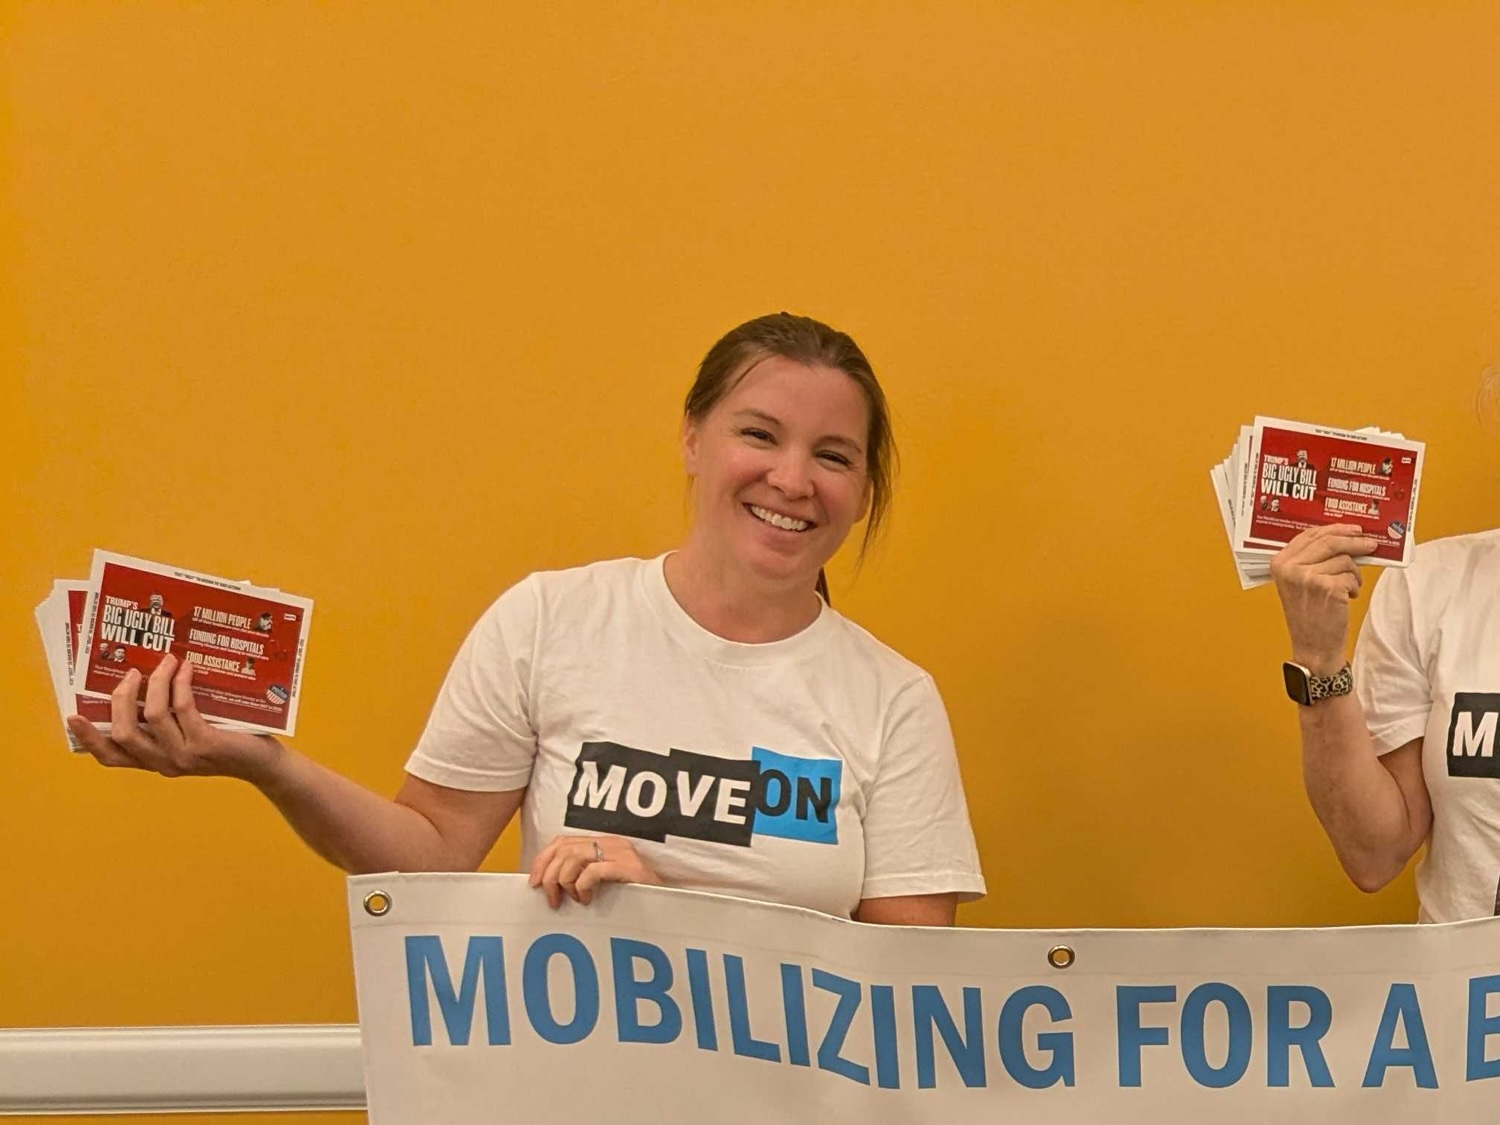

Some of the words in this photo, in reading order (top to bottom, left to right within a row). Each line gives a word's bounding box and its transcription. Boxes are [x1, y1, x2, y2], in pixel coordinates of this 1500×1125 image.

[1262, 462, 1277, 479] BIG
[1278, 465, 1299, 483] UGLY
[1300, 468, 1317, 486] BILL
[1261, 478, 1289, 497] WILL
[1292, 483, 1317, 501] CUT
[105, 595, 139, 610] TRUMP'S
[102, 604, 122, 625] BIG
[124, 609, 152, 631] UGLY
[152, 615, 175, 637] BILL
[193, 606, 202, 617] 17
[202, 608, 228, 624] MILLION
[227, 613, 252, 630] PEOPLE
[101, 622, 138, 646] WILL
[142, 632, 174, 654] CUT
[189, 628, 217, 645] FUNDING
[216, 634, 231, 648] FOR
[230, 636, 264, 655] HOSPITALS
[204, 654, 240, 673] ASSISTANCE
[404, 933, 1076, 1090] MOBILIZING
[1116, 982, 1336, 1089] FOR
[1362, 983, 1439, 1089] A
